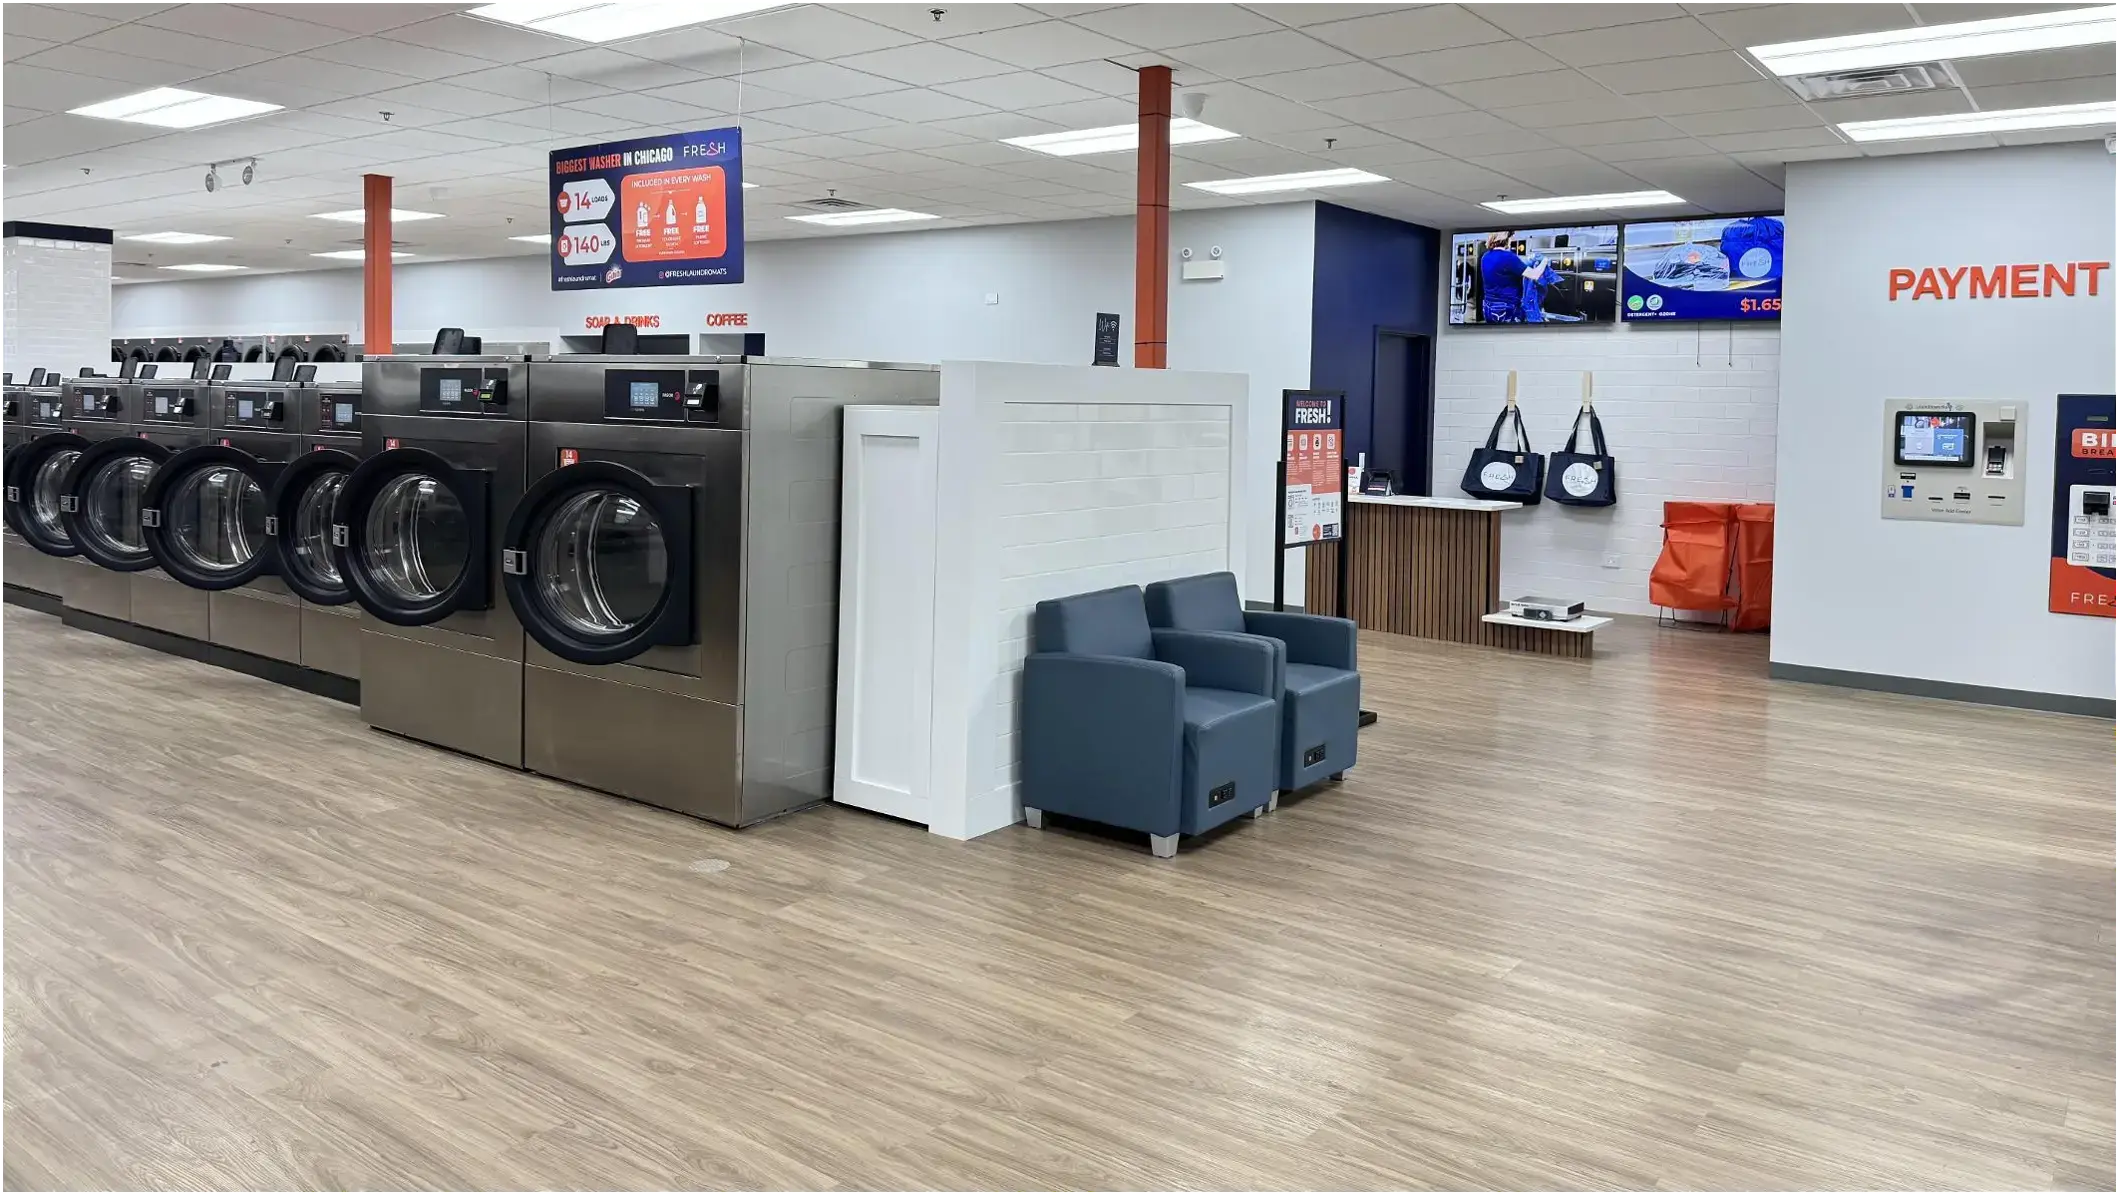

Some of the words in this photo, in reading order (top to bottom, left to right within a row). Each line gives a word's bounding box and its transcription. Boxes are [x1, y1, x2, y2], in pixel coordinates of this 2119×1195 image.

[683, 141, 726, 157] FRESH
[556, 158, 587, 174] BIGGEST
[589, 154, 621, 170] WASHER
[623, 151, 632, 166] IN
[634, 147, 673, 165] CHICAGO
[631, 177, 662, 188] INCLUDED
[664, 177, 669, 185] IN
[671, 175, 691, 184] EVERY
[692, 173, 711, 182] WASH
[574, 191, 592, 210] 14
[592, 195, 608, 203] LOADS
[635, 228, 651, 237] FREE
[663, 226, 679, 235] FREE
[693, 225, 709, 233] FREE
[574, 235, 599, 254] 140
[600, 239, 610, 247] LBS
[664, 268, 727, 278] @FRESHLAUNDROMATS
[1889, 262, 2110, 301] PAYMENT
[1740, 297, 1782, 313] $1.65
[625, 315, 660, 328] DRINKS
[706, 313, 748, 327] COFFEE
[565, 450, 573, 459] 14
